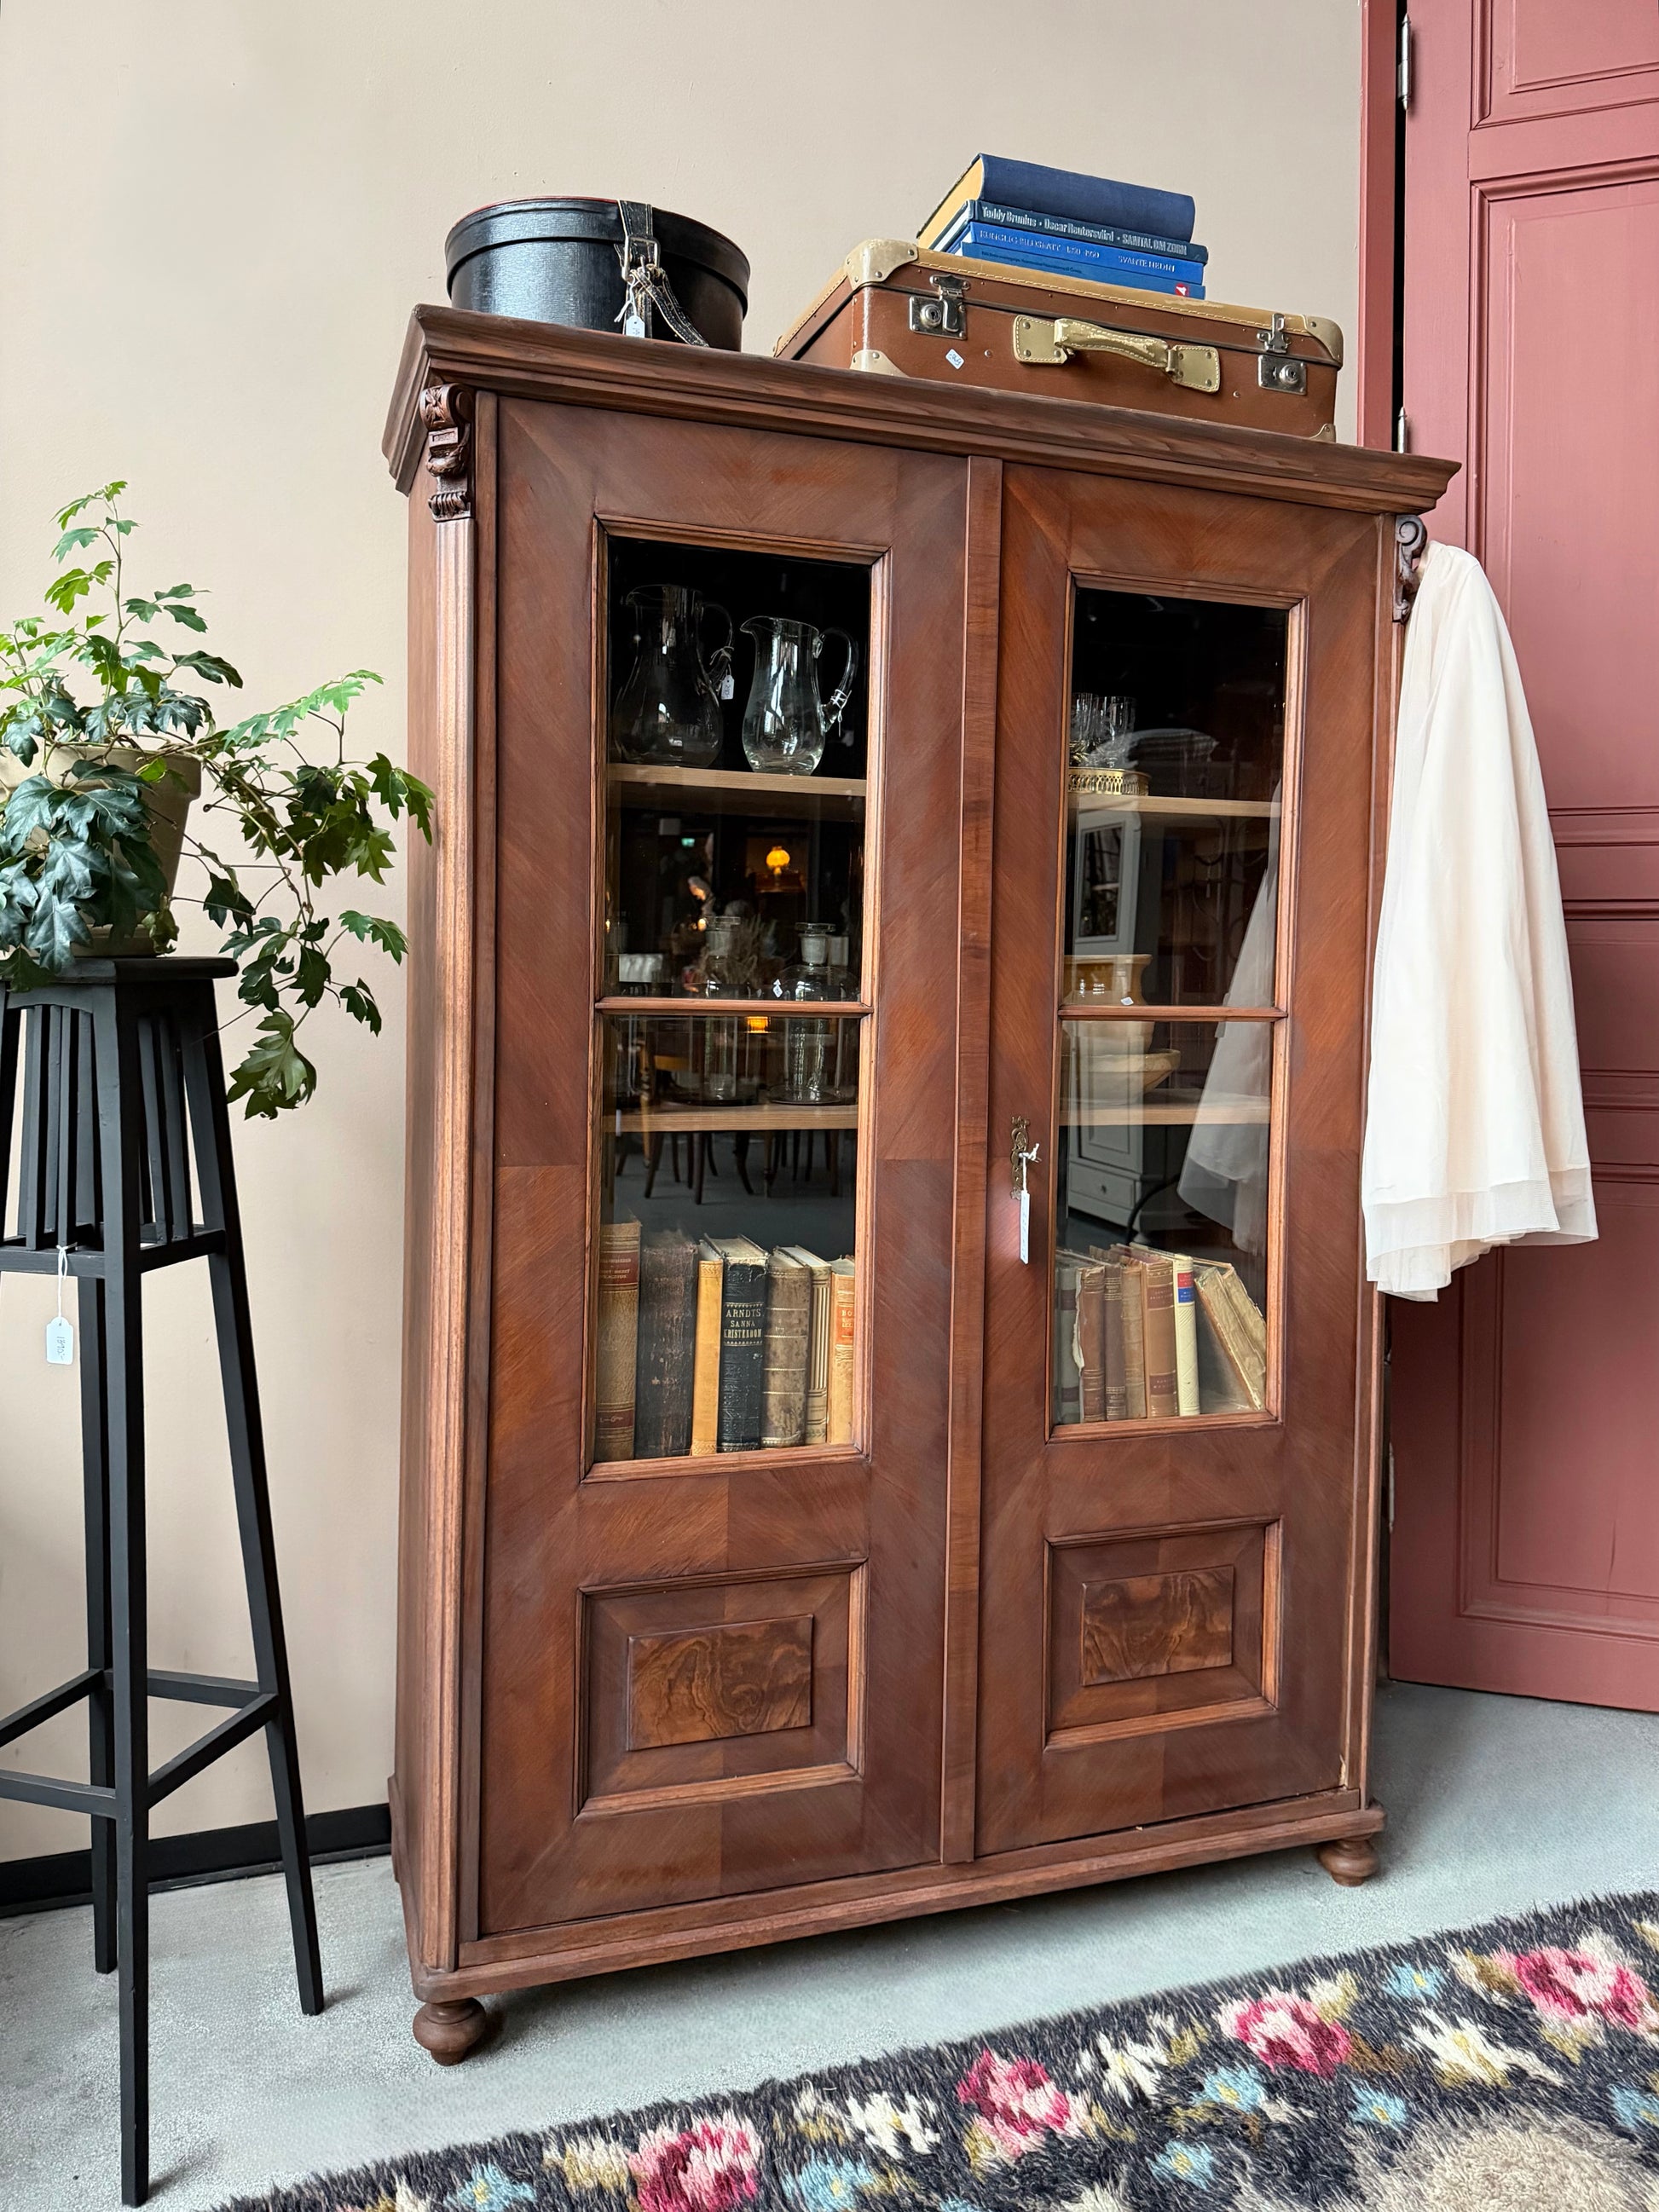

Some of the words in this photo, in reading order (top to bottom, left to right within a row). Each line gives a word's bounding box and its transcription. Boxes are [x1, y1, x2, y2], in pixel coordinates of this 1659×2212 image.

[981, 205, 1006, 222] Teddy
[1006, 211, 1037, 228] Brunius
[1043, 217, 1067, 233] Oscar
[1122, 233, 1153, 250] SAMTAL
[1153, 240, 1166, 253] OM
[1166, 241, 1188, 256] ZORN
[730, 1320, 756, 1328] SANNA
